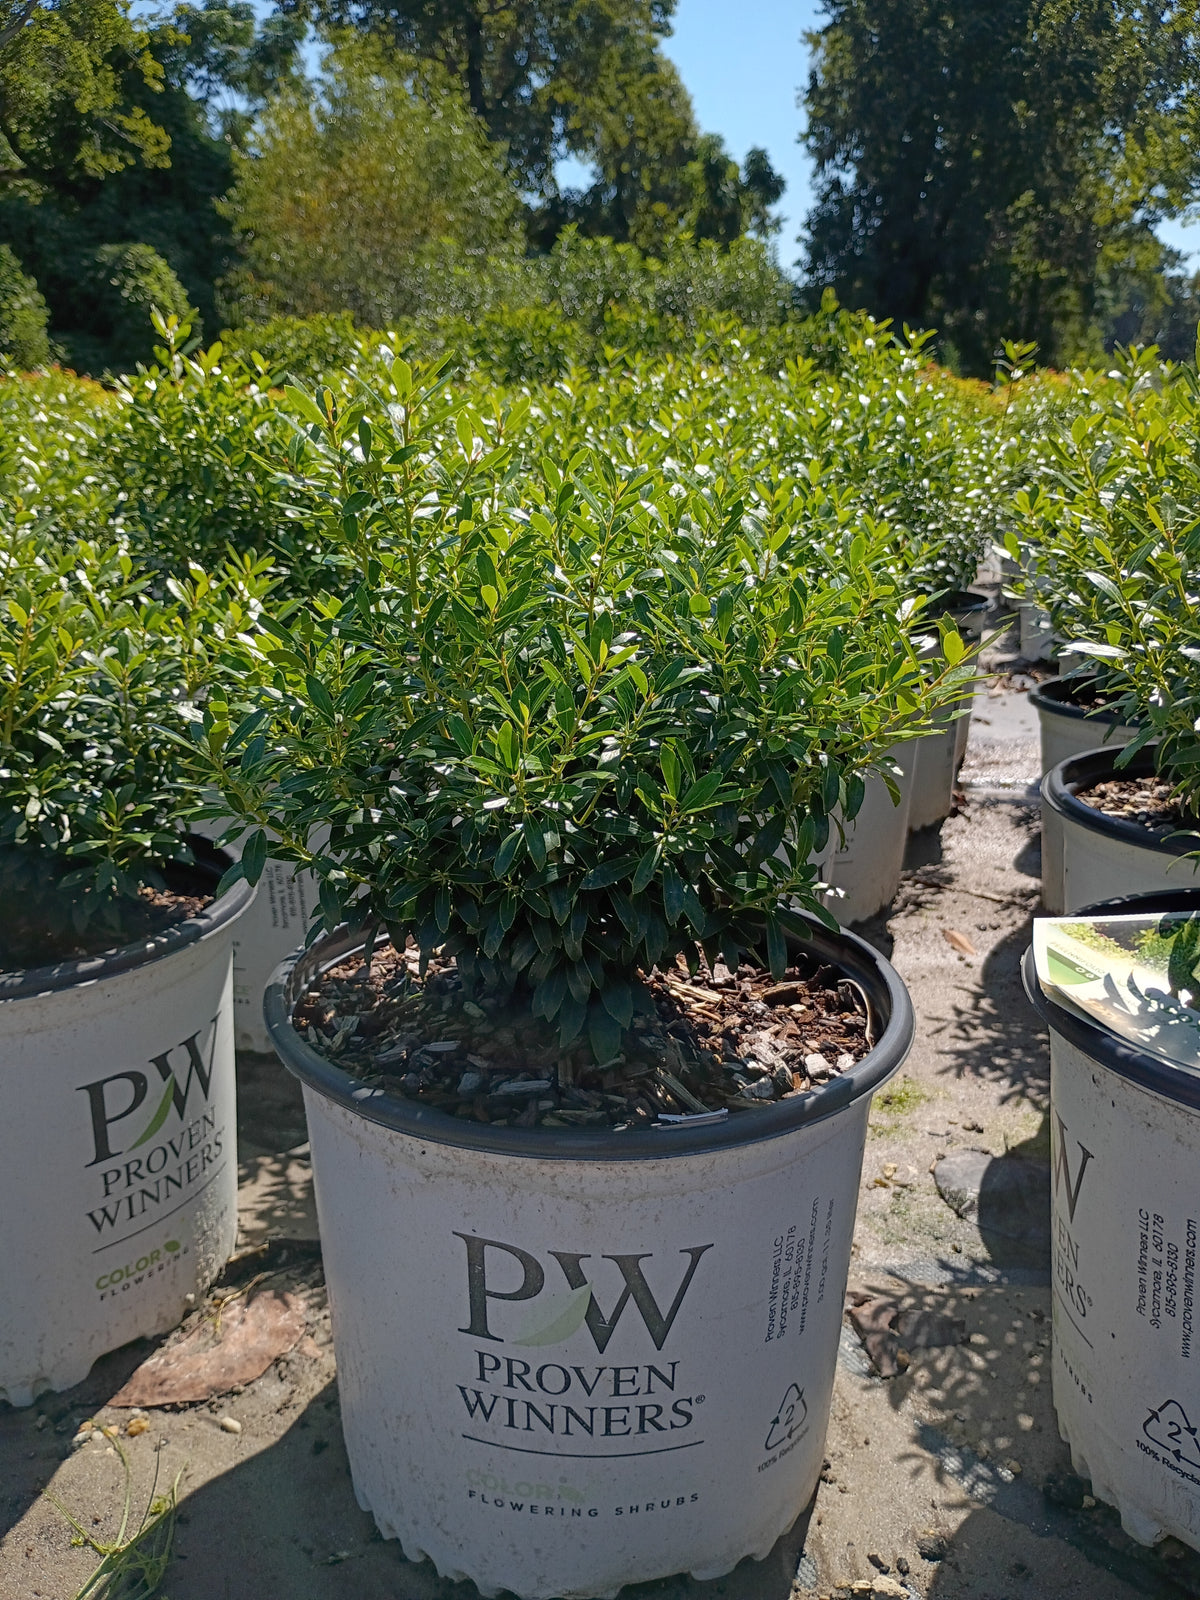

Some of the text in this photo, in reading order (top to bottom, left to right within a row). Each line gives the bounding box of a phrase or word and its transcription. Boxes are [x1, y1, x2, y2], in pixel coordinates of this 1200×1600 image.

[75, 1011, 222, 1167] PW
[101, 1104, 216, 1197] PROVEN
[96, 1250, 161, 1290] COLOR
[452, 1230, 714, 1354] PW
[765, 1236, 783, 1342] Proven Winners LLC
[777, 1277, 791, 1339] Sycamore,
[785, 1225, 796, 1261] 60178
[1136, 1208, 1149, 1316] Proven Winners LLC
[1150, 1214, 1164, 1329] Sycamore, IL 60178
[1165, 1243, 1178, 1317] 815-895-8130
[1181, 1218, 1197, 1358] www.provenwinners.com
[474, 1350, 680, 1397] PROVEN
[468, 1490, 698, 1517] FLOWERING SHRUBS
[1136, 1440, 1160, 1462] 100%
